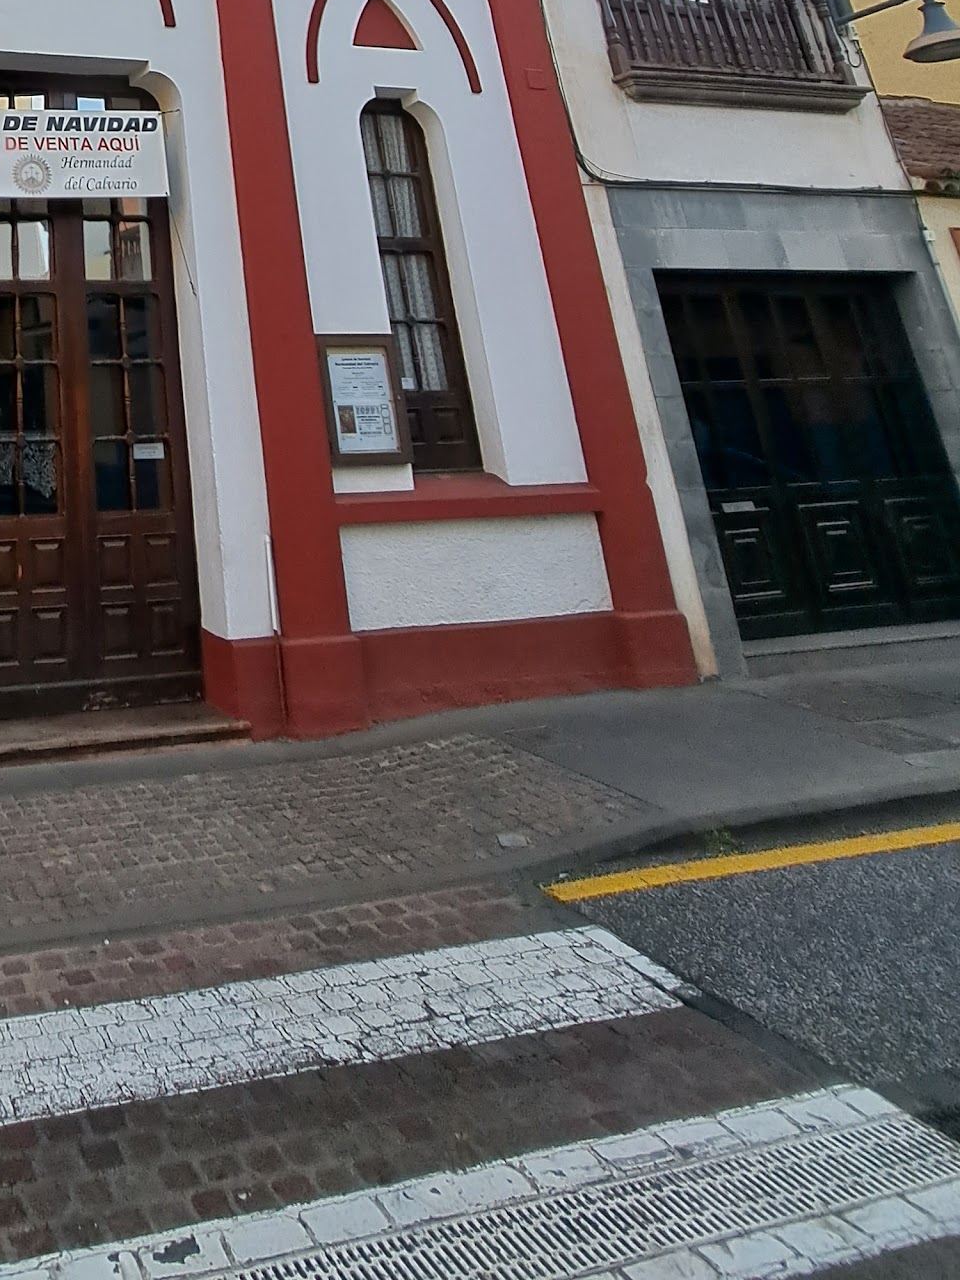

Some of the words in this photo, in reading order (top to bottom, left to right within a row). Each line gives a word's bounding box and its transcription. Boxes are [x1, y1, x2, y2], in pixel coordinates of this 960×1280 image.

[3, 115, 38, 131] DE
[46, 116, 158, 132] NAVIDAD
[5, 136, 29, 151] DE
[34, 136, 93, 152] VENTA
[97, 135, 140, 152] AQUÍ
[61, 155, 135, 169] Hermandad
[64, 176, 85, 191] del
[86, 177, 138, 191] Calvario
